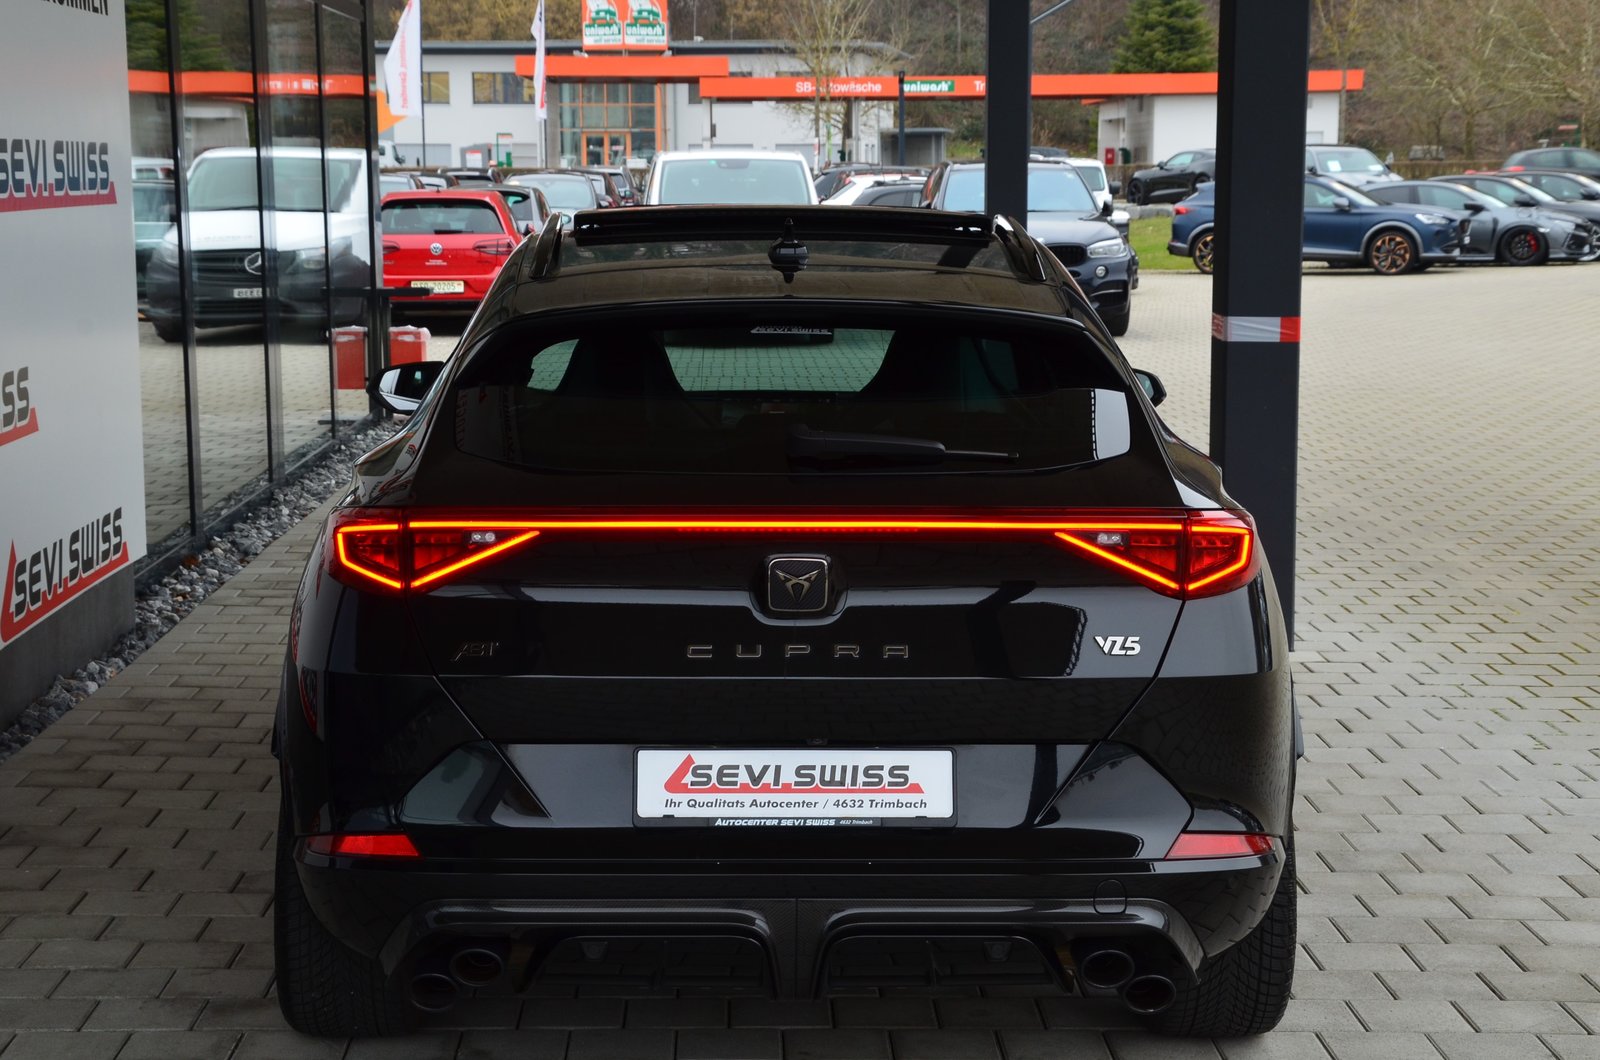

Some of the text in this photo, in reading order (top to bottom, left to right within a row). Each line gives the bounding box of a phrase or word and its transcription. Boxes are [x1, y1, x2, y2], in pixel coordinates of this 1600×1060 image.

[53, 140, 109, 192] SWISS
[14, 506, 123, 619] SEVI SWISS
[687, 644, 909, 658] CUPRA
[1093, 635, 1141, 656] VZ5
[689, 764, 910, 788] SEVI SWISS
[664, 798, 928, 810] Ihr Qualitats Autocenter / 4632 Trimbach
[780, 818, 804, 826] SEVI
[805, 818, 836, 826] SWISS
